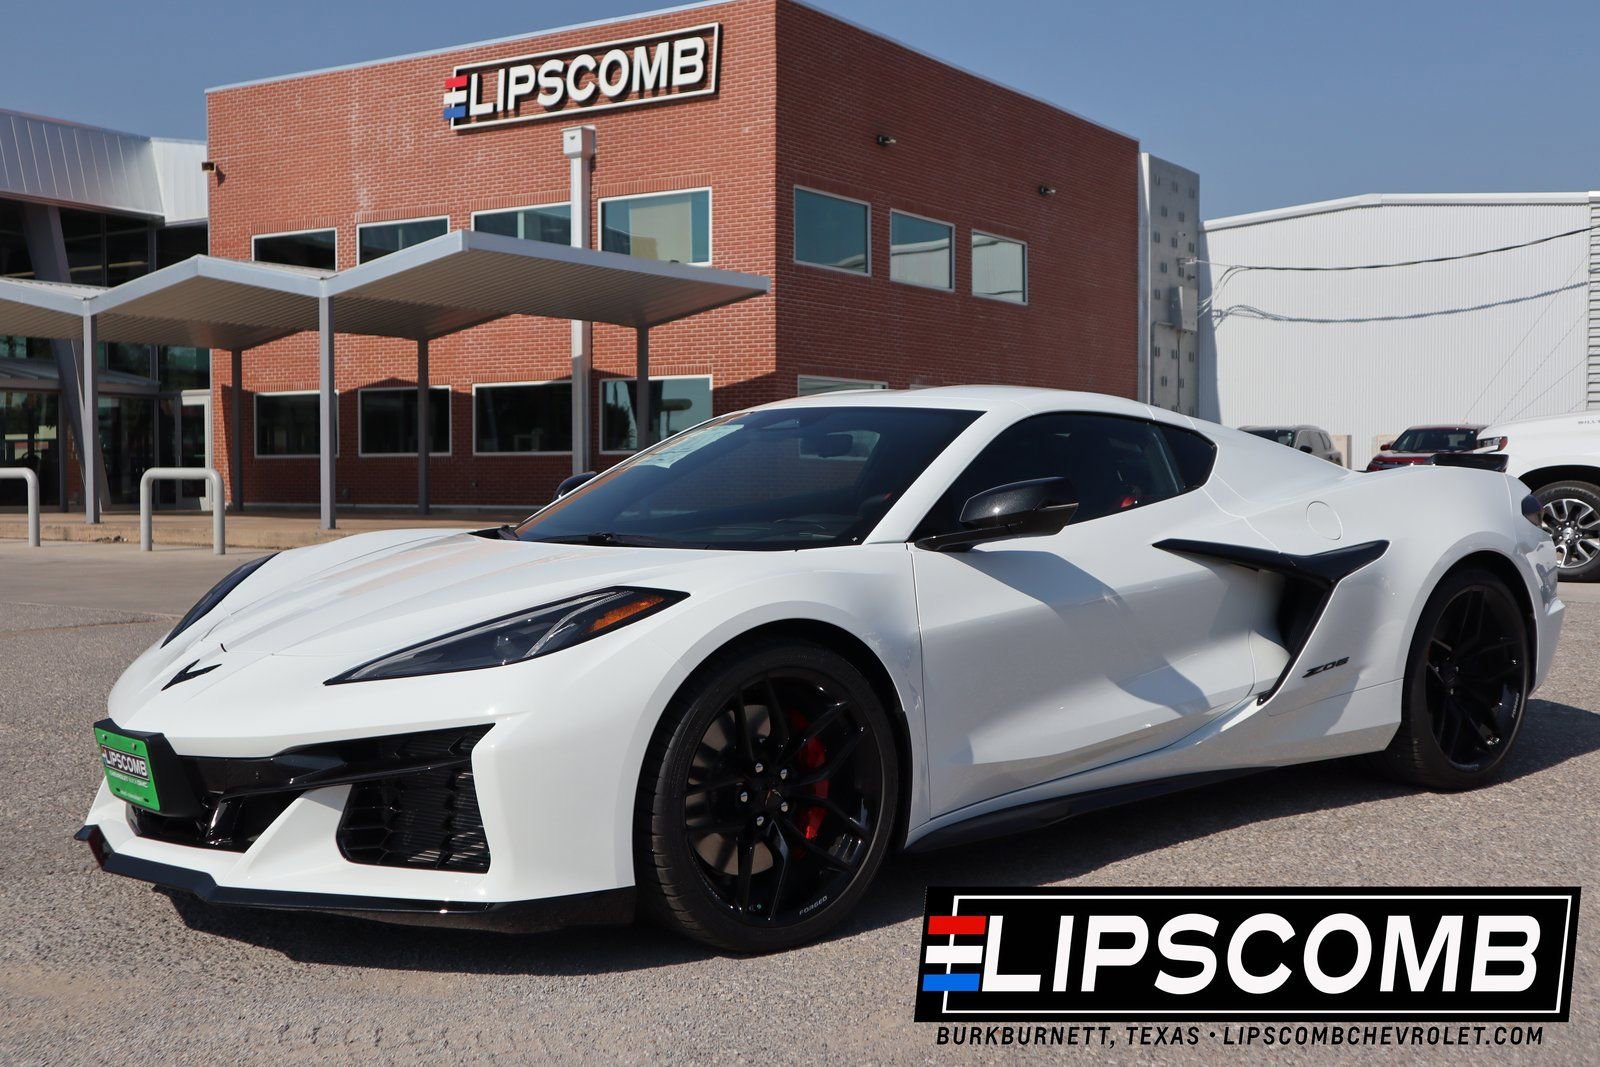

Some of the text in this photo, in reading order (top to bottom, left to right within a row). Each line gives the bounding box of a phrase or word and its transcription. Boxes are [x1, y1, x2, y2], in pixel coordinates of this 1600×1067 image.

[469, 36, 705, 116] LIPSCOMB
[1302, 656, 1350, 678] Z06
[104, 750, 148, 776] LIPSCOMB
[799, 895, 828, 915] FORGED
